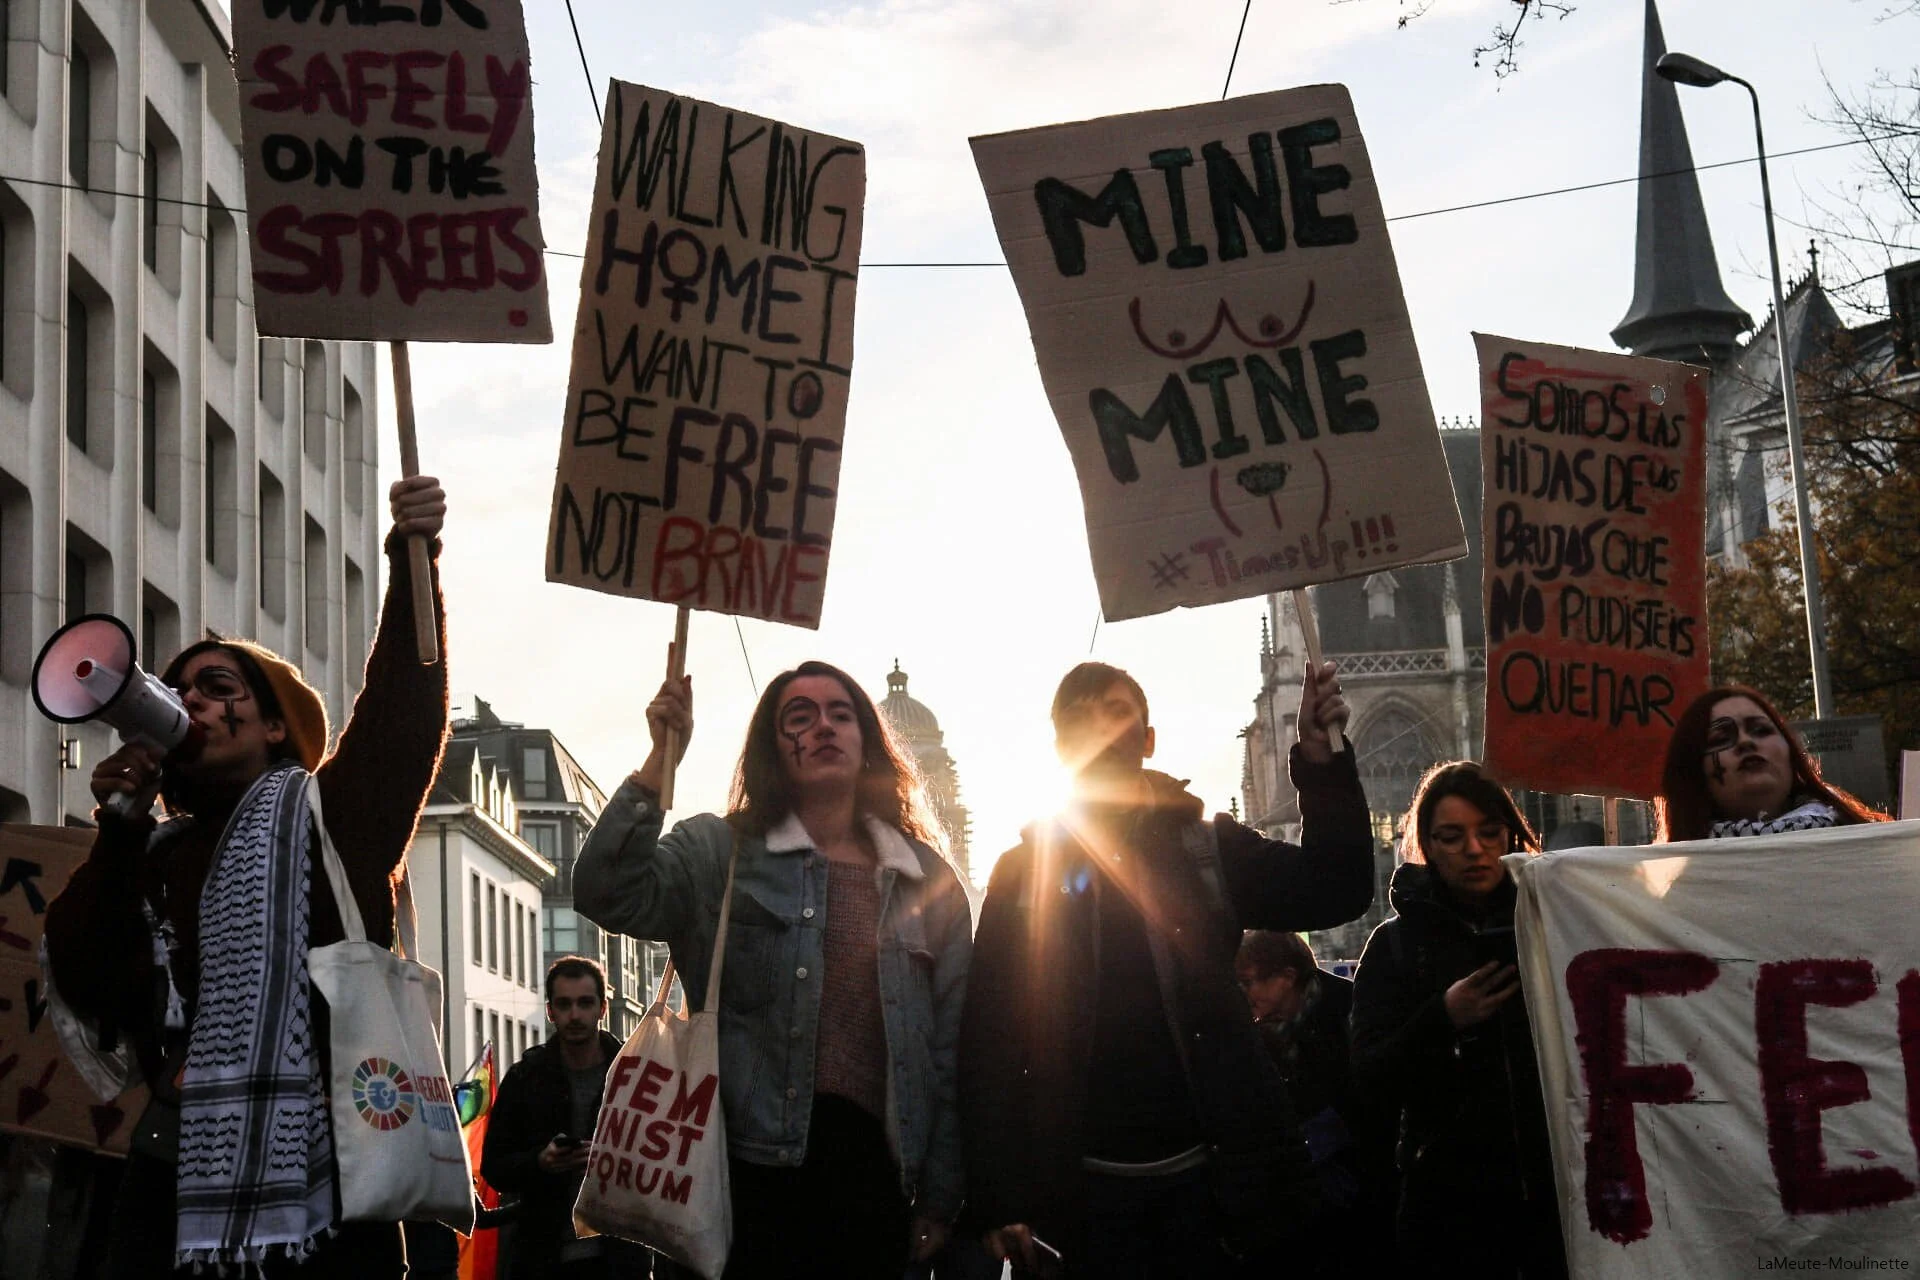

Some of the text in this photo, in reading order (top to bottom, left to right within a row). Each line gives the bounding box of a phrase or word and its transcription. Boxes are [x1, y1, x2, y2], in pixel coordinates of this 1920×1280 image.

[250, 44, 529, 157] SAFELY
[261, 133, 507, 199] ON THE
[611, 81, 861, 262] WALKING
[1034, 116, 1359, 278] MINE
[596, 208, 808, 344] HOME
[595, 309, 825, 421] WANT TO
[1089, 328, 1380, 485] MINE
[574, 388, 843, 547] BE FREE
[1637, 403, 1687, 449] LAS
[1602, 453, 1648, 515] DE
[554, 483, 827, 622] NOT BRAVE
[1490, 571, 1545, 644] NO
[1602, 529, 1670, 587] QUE
[607, 1055, 718, 1128] FEM
[1566, 946, 1920, 1249] FE
